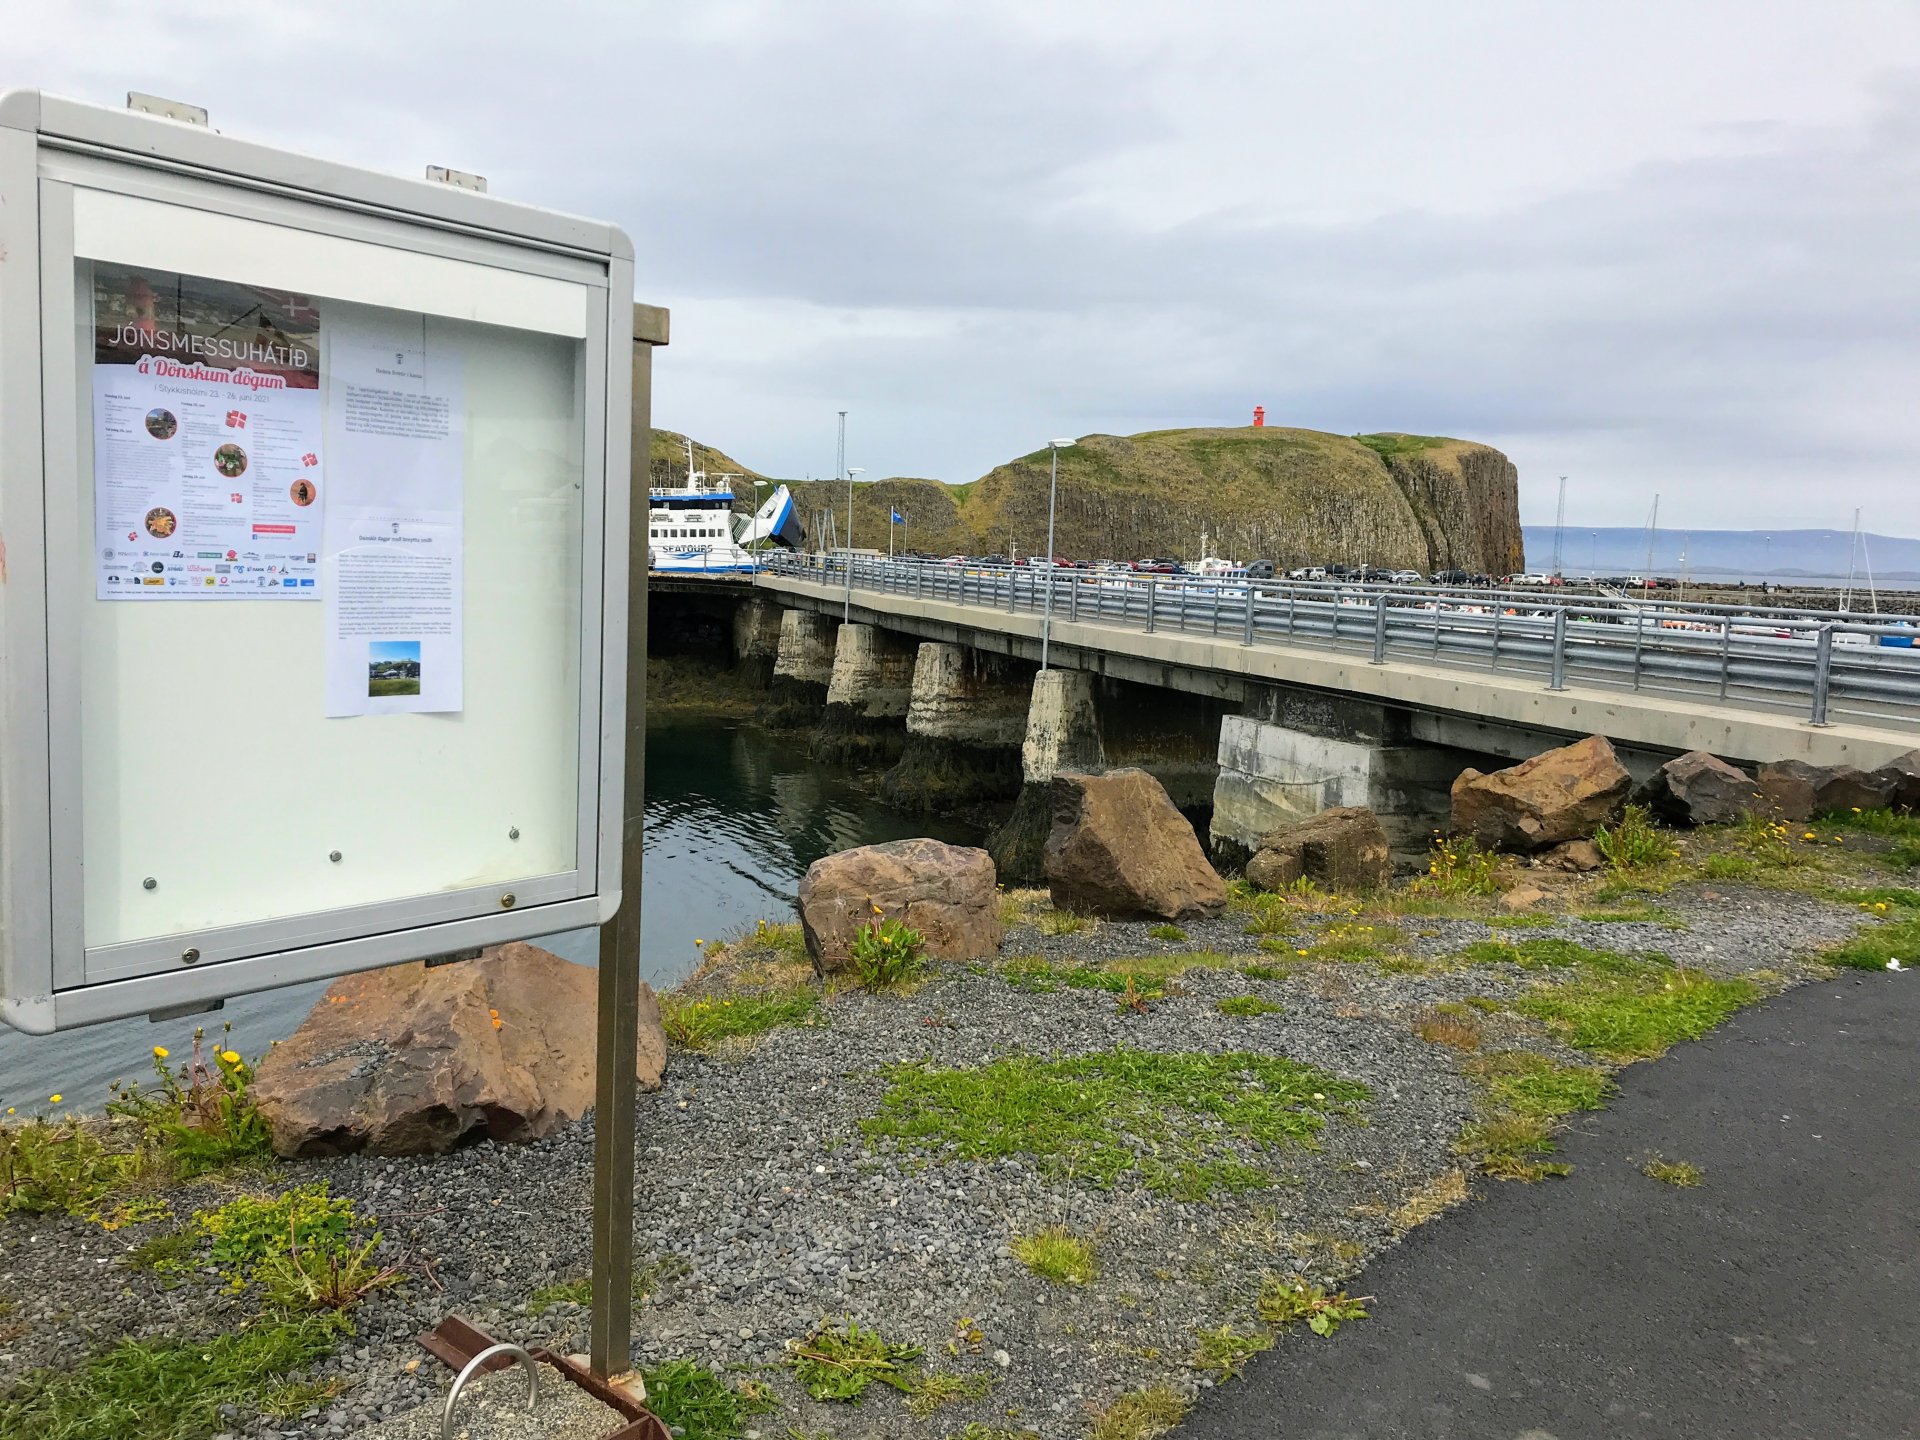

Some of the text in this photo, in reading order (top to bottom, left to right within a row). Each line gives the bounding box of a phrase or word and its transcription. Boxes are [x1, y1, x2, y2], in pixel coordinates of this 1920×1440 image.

[108, 321, 308, 368] JÓNSMESSUHÁTÍÐ
[138, 358, 283, 392] á Dönskum dögum
[253, 394, 270, 403] 2021
[662, 544, 713, 553] SEATOURS
